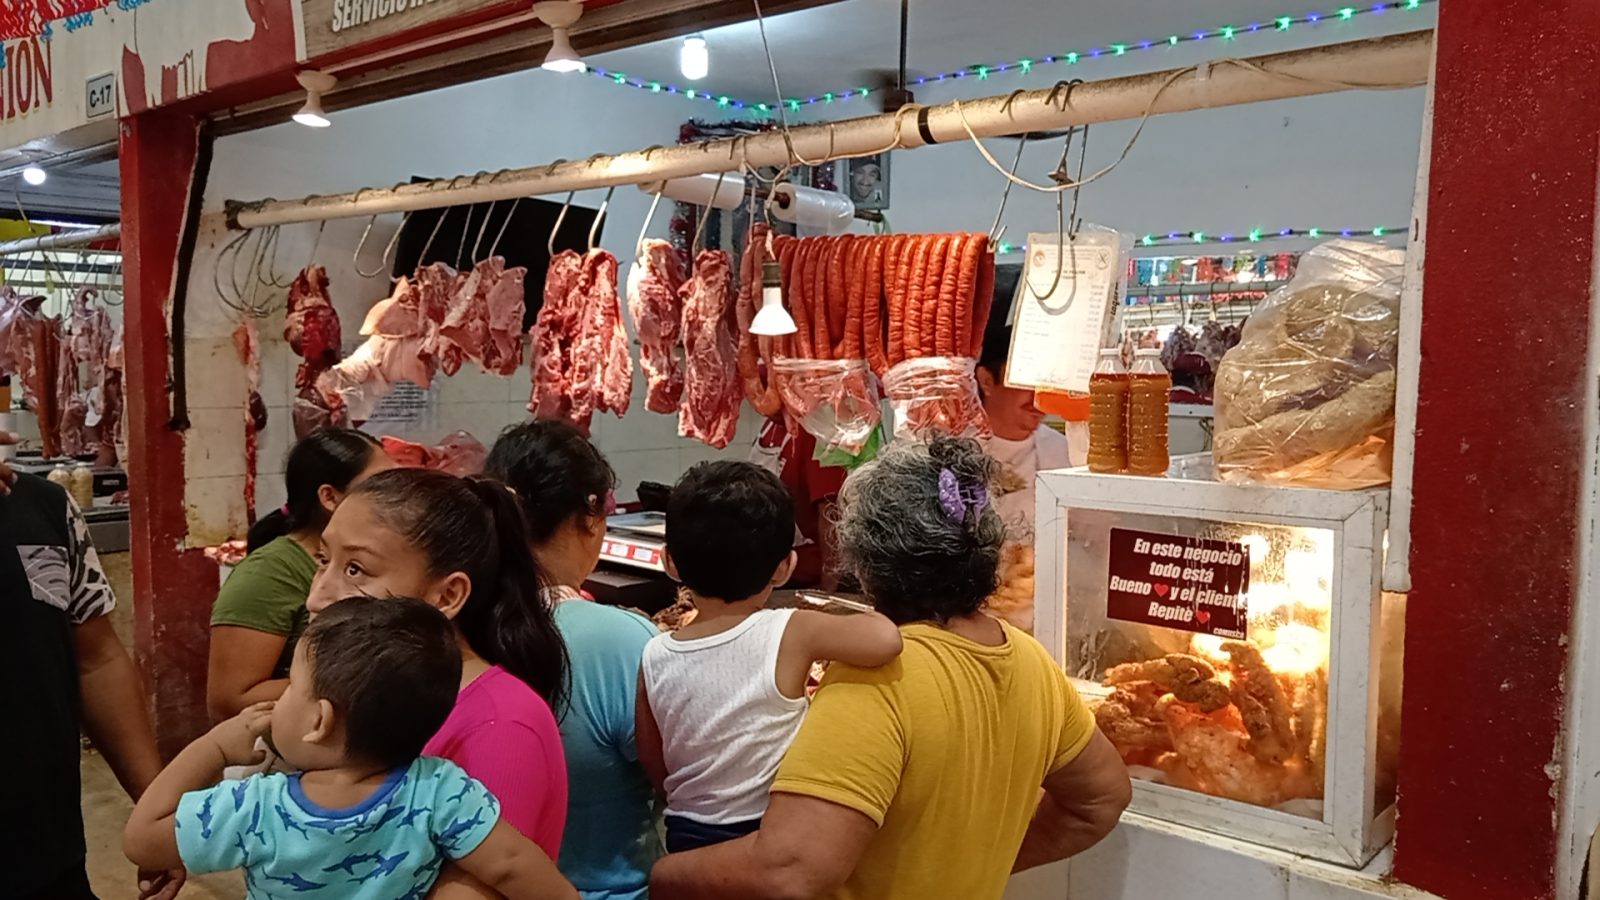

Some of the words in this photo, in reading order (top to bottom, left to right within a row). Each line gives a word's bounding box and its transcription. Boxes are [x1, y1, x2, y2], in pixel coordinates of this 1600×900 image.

[0, 36, 52, 119] ION
[89, 85, 112, 108] C-17
[1134, 538, 1150, 554] En
[1152, 543, 1182, 558] este
[1183, 547, 1242, 566] negocio
[1149, 561, 1181, 578] todo
[1182, 567, 1214, 584] está
[1109, 576, 1152, 596] Bueno
[1169, 587, 1180, 601] y
[1180, 586, 1196, 602] el
